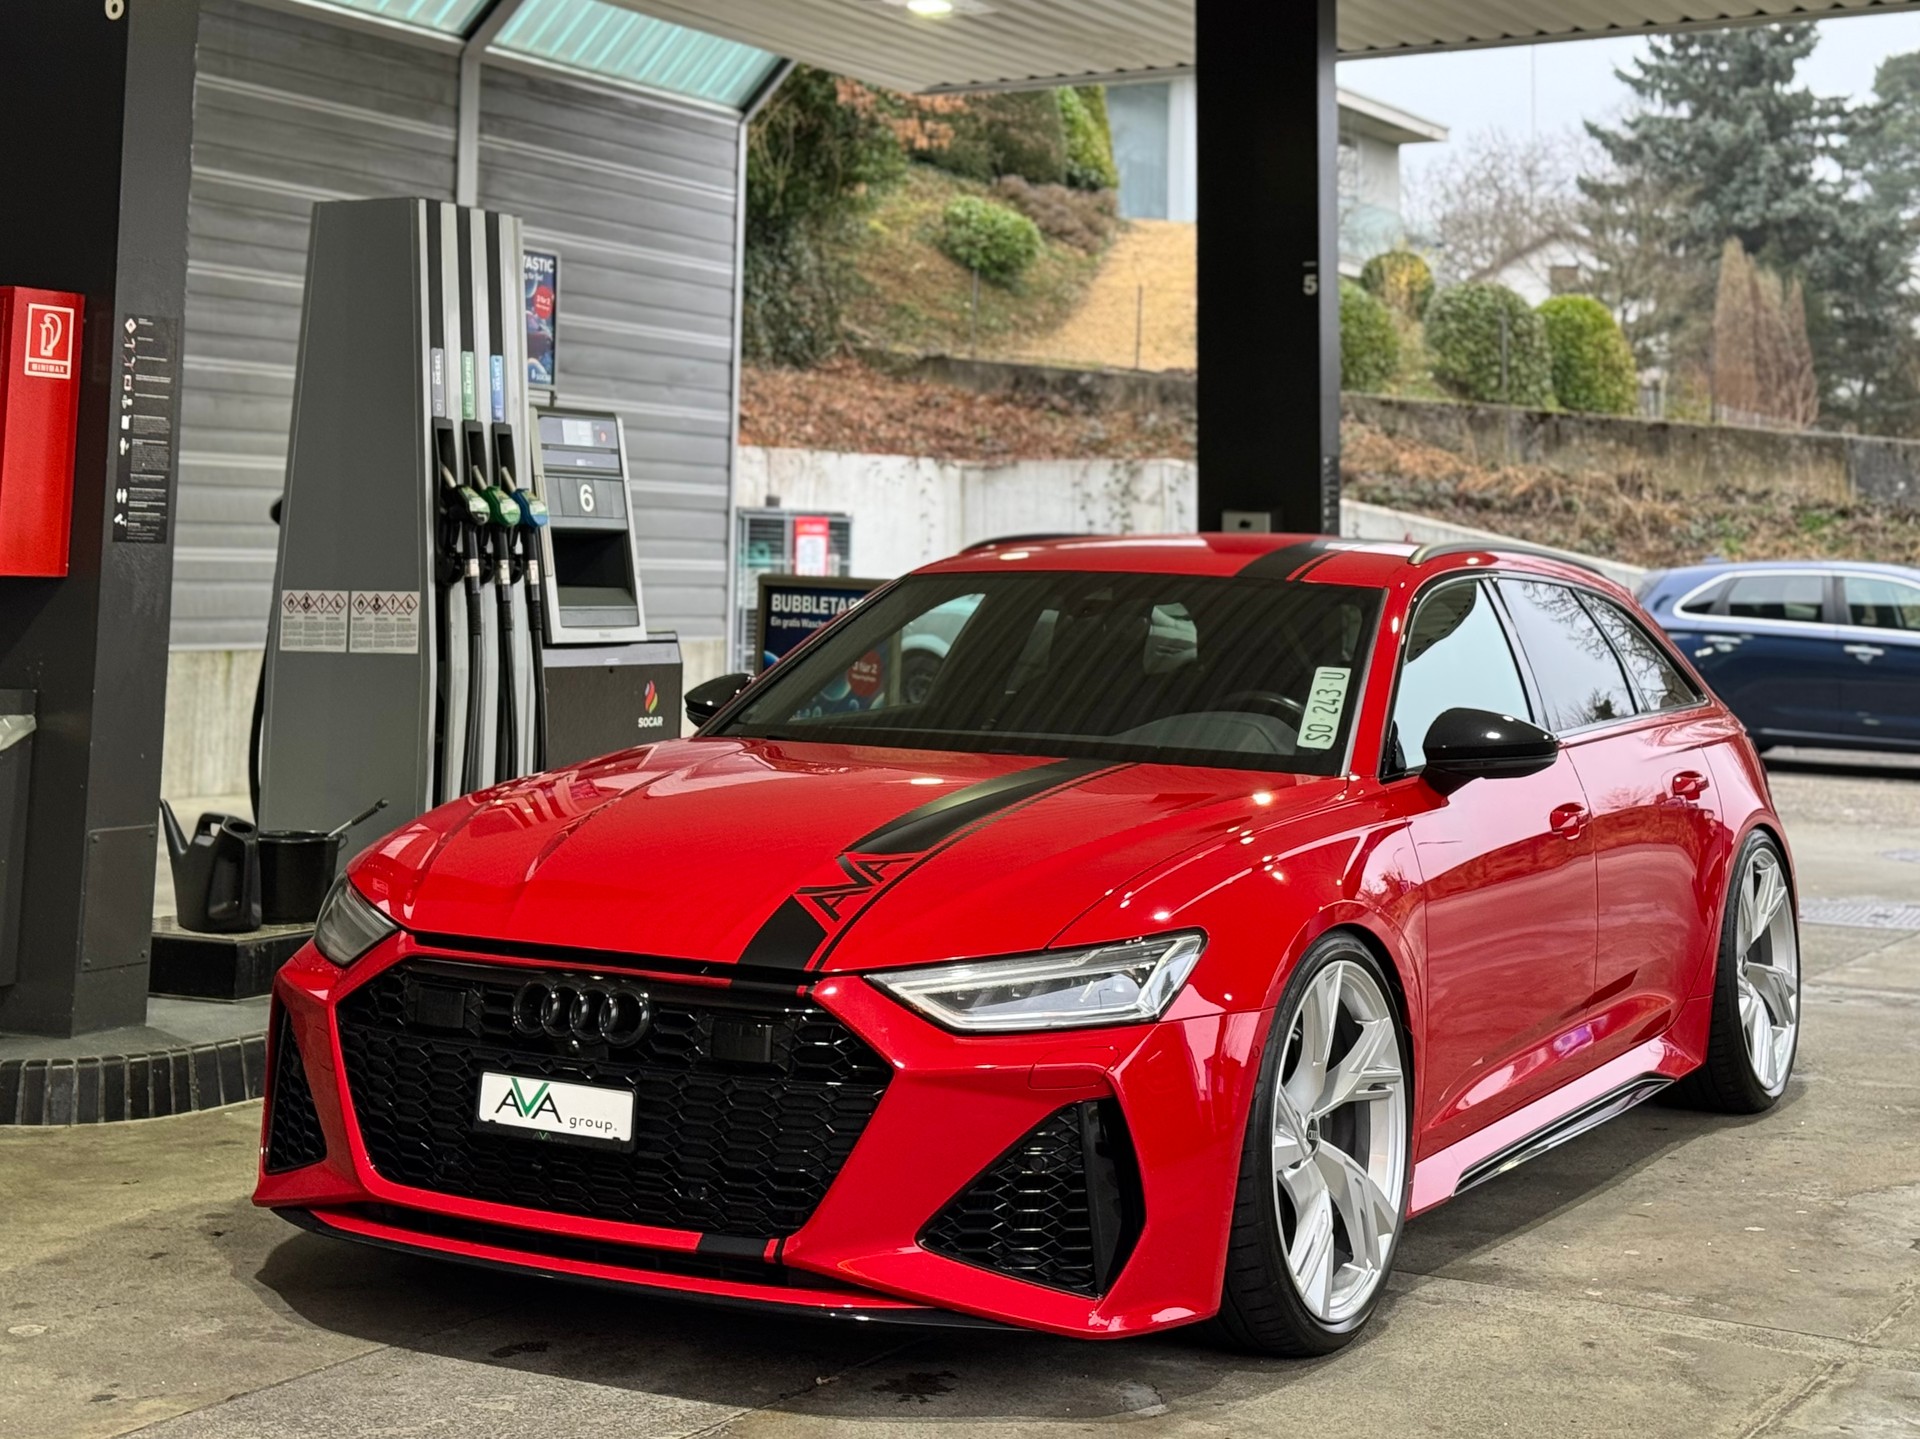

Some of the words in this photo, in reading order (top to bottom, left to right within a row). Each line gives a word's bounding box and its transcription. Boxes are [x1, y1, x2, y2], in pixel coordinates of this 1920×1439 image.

[105, 0, 125, 20] 6
[1303, 273, 1318, 296] 5
[434, 354, 442, 386] DIESEL
[579, 484, 595, 512] 6
[638, 716, 663, 728] SOCAR
[797, 852, 915, 922] AVA
[494, 1077, 563, 1124] AVA
[569, 1117, 618, 1133] group.
